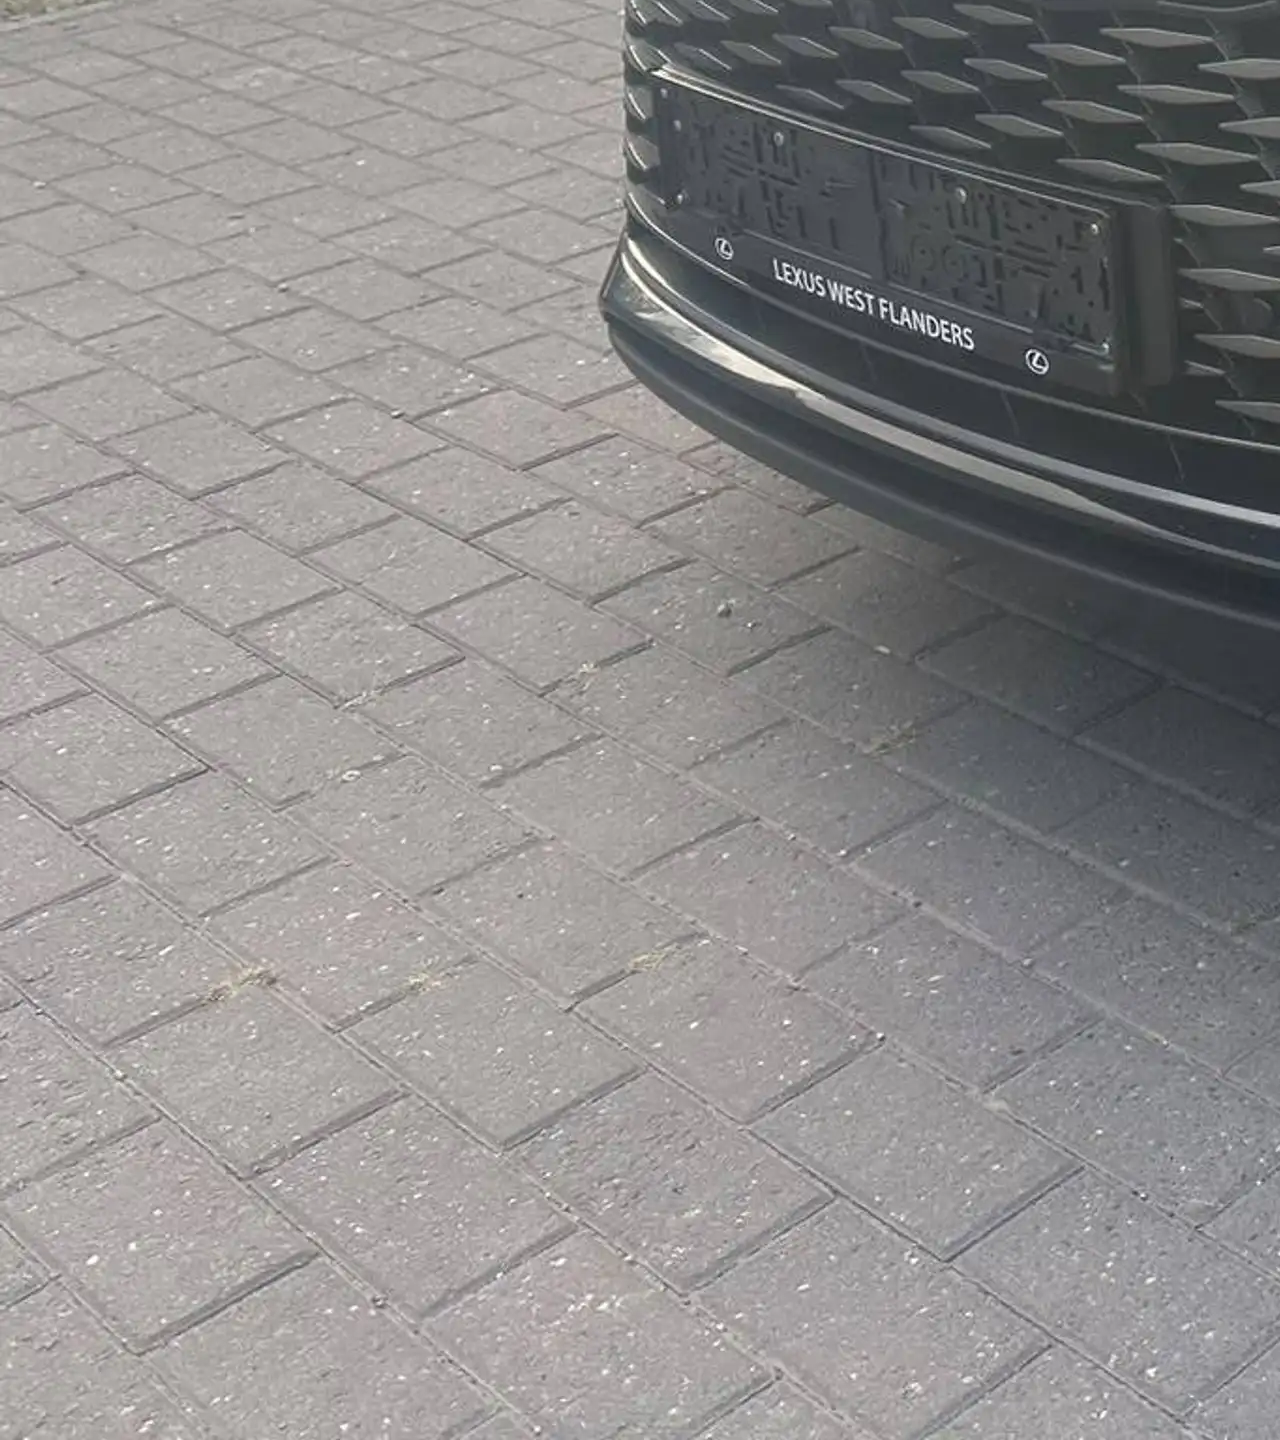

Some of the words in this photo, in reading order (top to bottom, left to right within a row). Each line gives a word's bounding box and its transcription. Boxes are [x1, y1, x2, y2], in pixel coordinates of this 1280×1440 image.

[773, 258, 826, 297] LEXUS
[827, 279, 874, 315] WEST
[878, 298, 975, 350] FLANDERS
